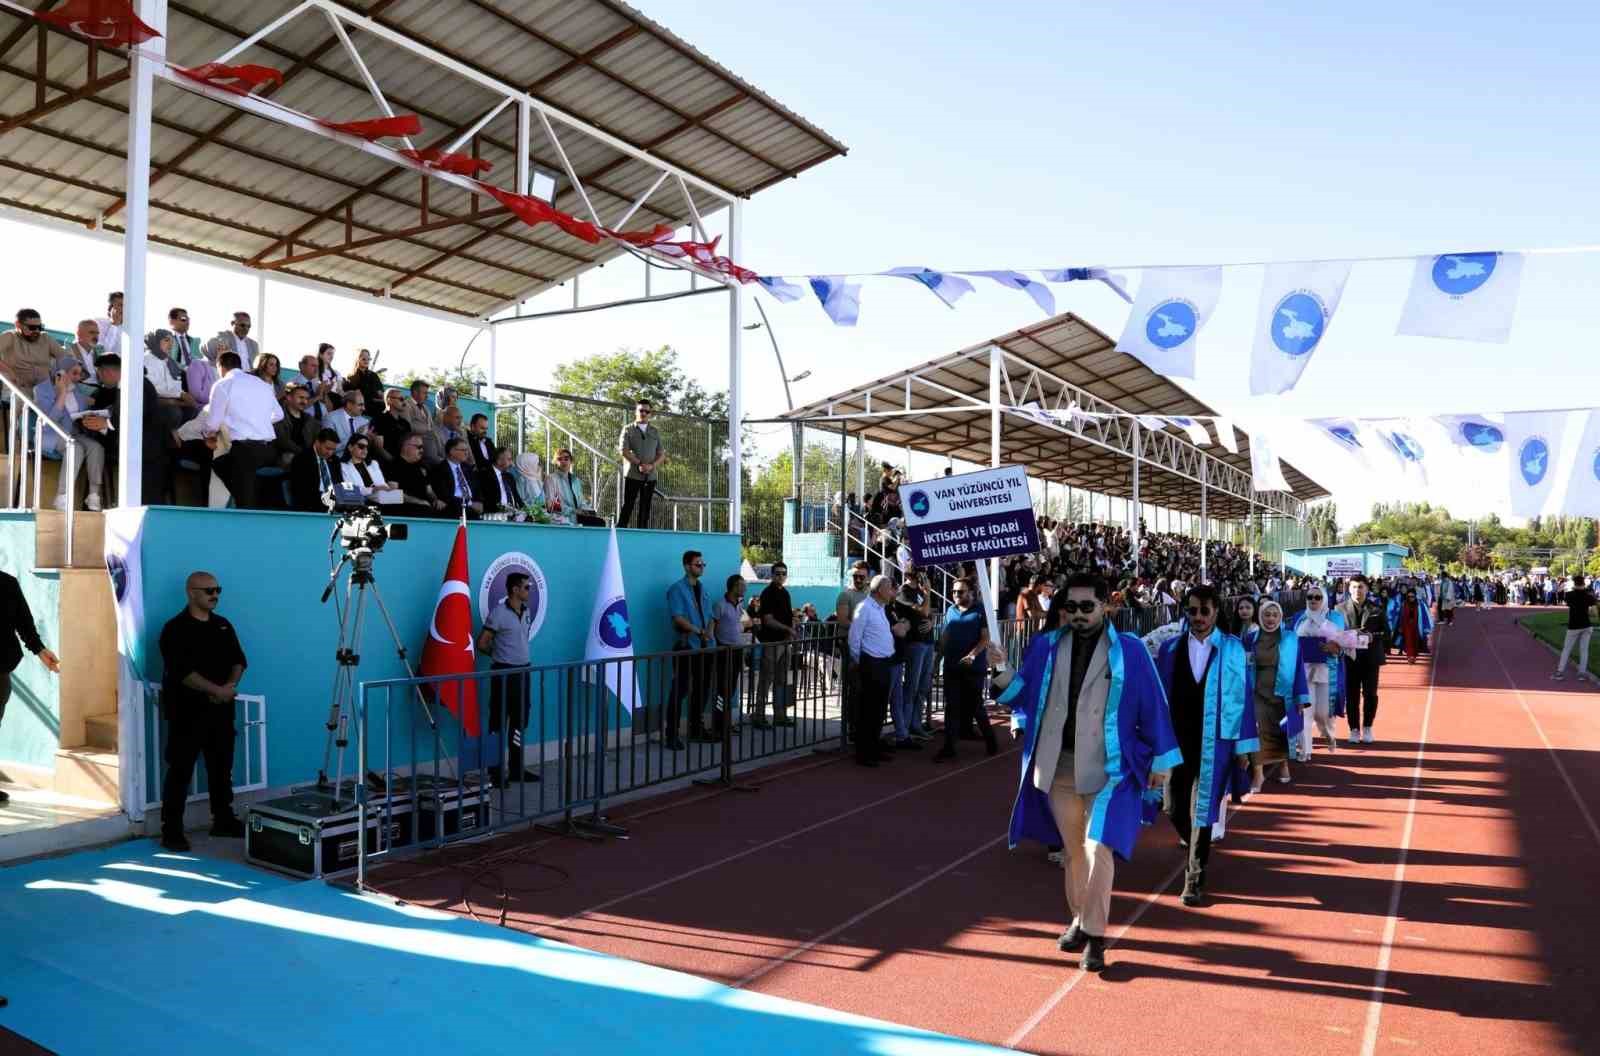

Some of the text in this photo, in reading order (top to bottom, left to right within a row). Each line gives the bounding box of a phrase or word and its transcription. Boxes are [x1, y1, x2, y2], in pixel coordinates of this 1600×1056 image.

[934, 477, 1022, 500] VAN YÜZÜNCÜ YIL
[949, 490, 1012, 511] ÜNİVERSİTESİ
[923, 518, 1020, 544] İKTİSADİ VE İDARİ
[921, 532, 1028, 558] BİLİMLER FAKÜLTESİ
